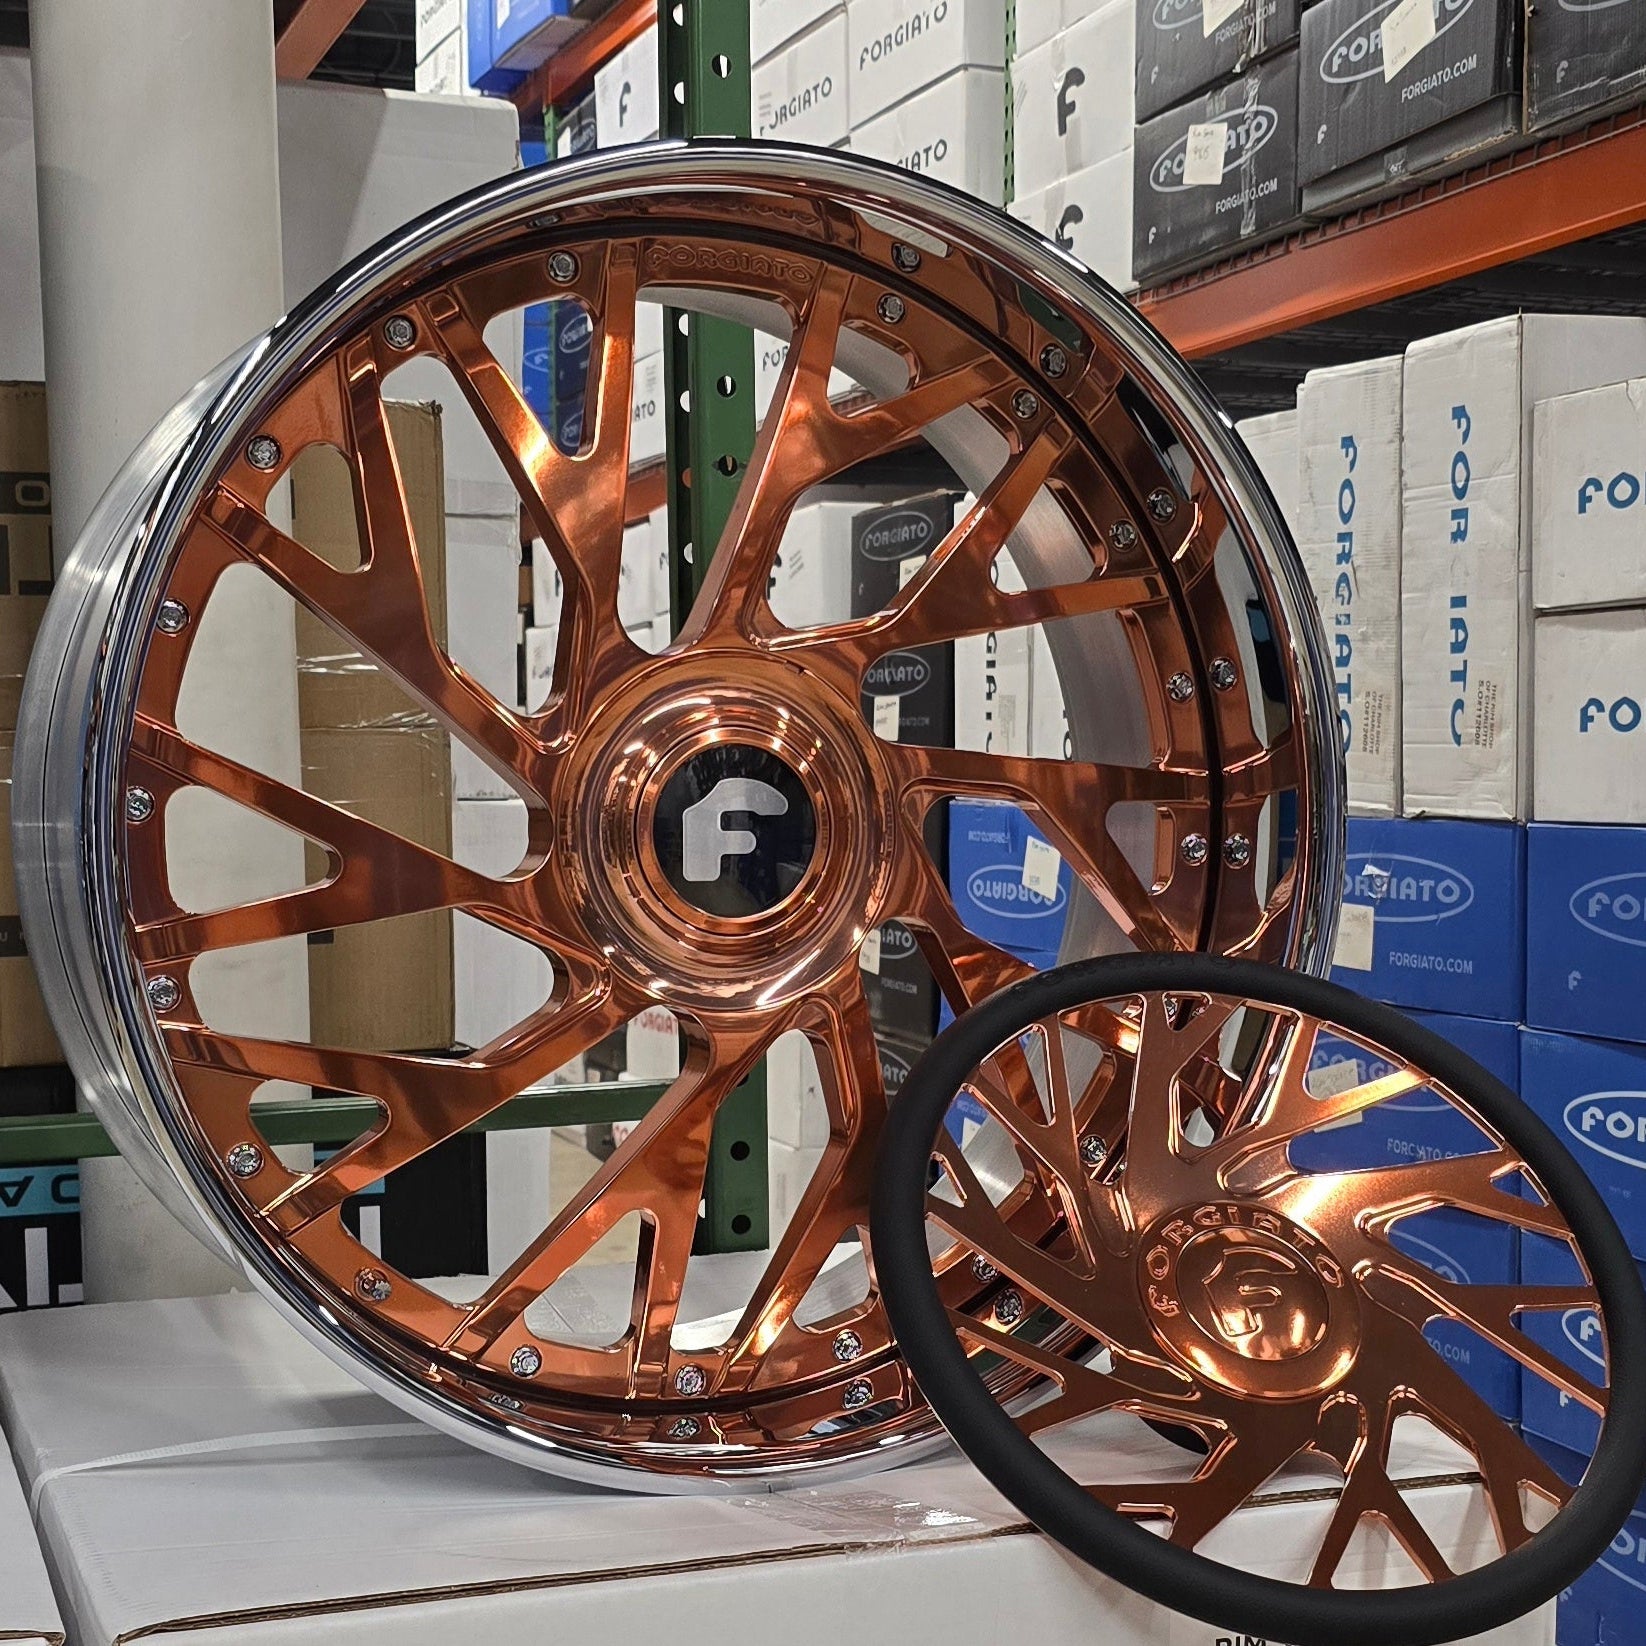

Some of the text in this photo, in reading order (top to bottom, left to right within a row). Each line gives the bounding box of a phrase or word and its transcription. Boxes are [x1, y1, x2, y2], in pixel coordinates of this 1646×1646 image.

[860, 1, 948, 71] FORGIATO
[1402, 54, 1478, 103] FORGIATO.COM
[646, 245, 813, 284] FORGIATO
[1578, 472, 1646, 515] FO
[1588, 892, 1646, 921] FO
[1389, 951, 1473, 975] FORGIATO.COM
[1146, 1205, 1345, 1318] FORGIATO
